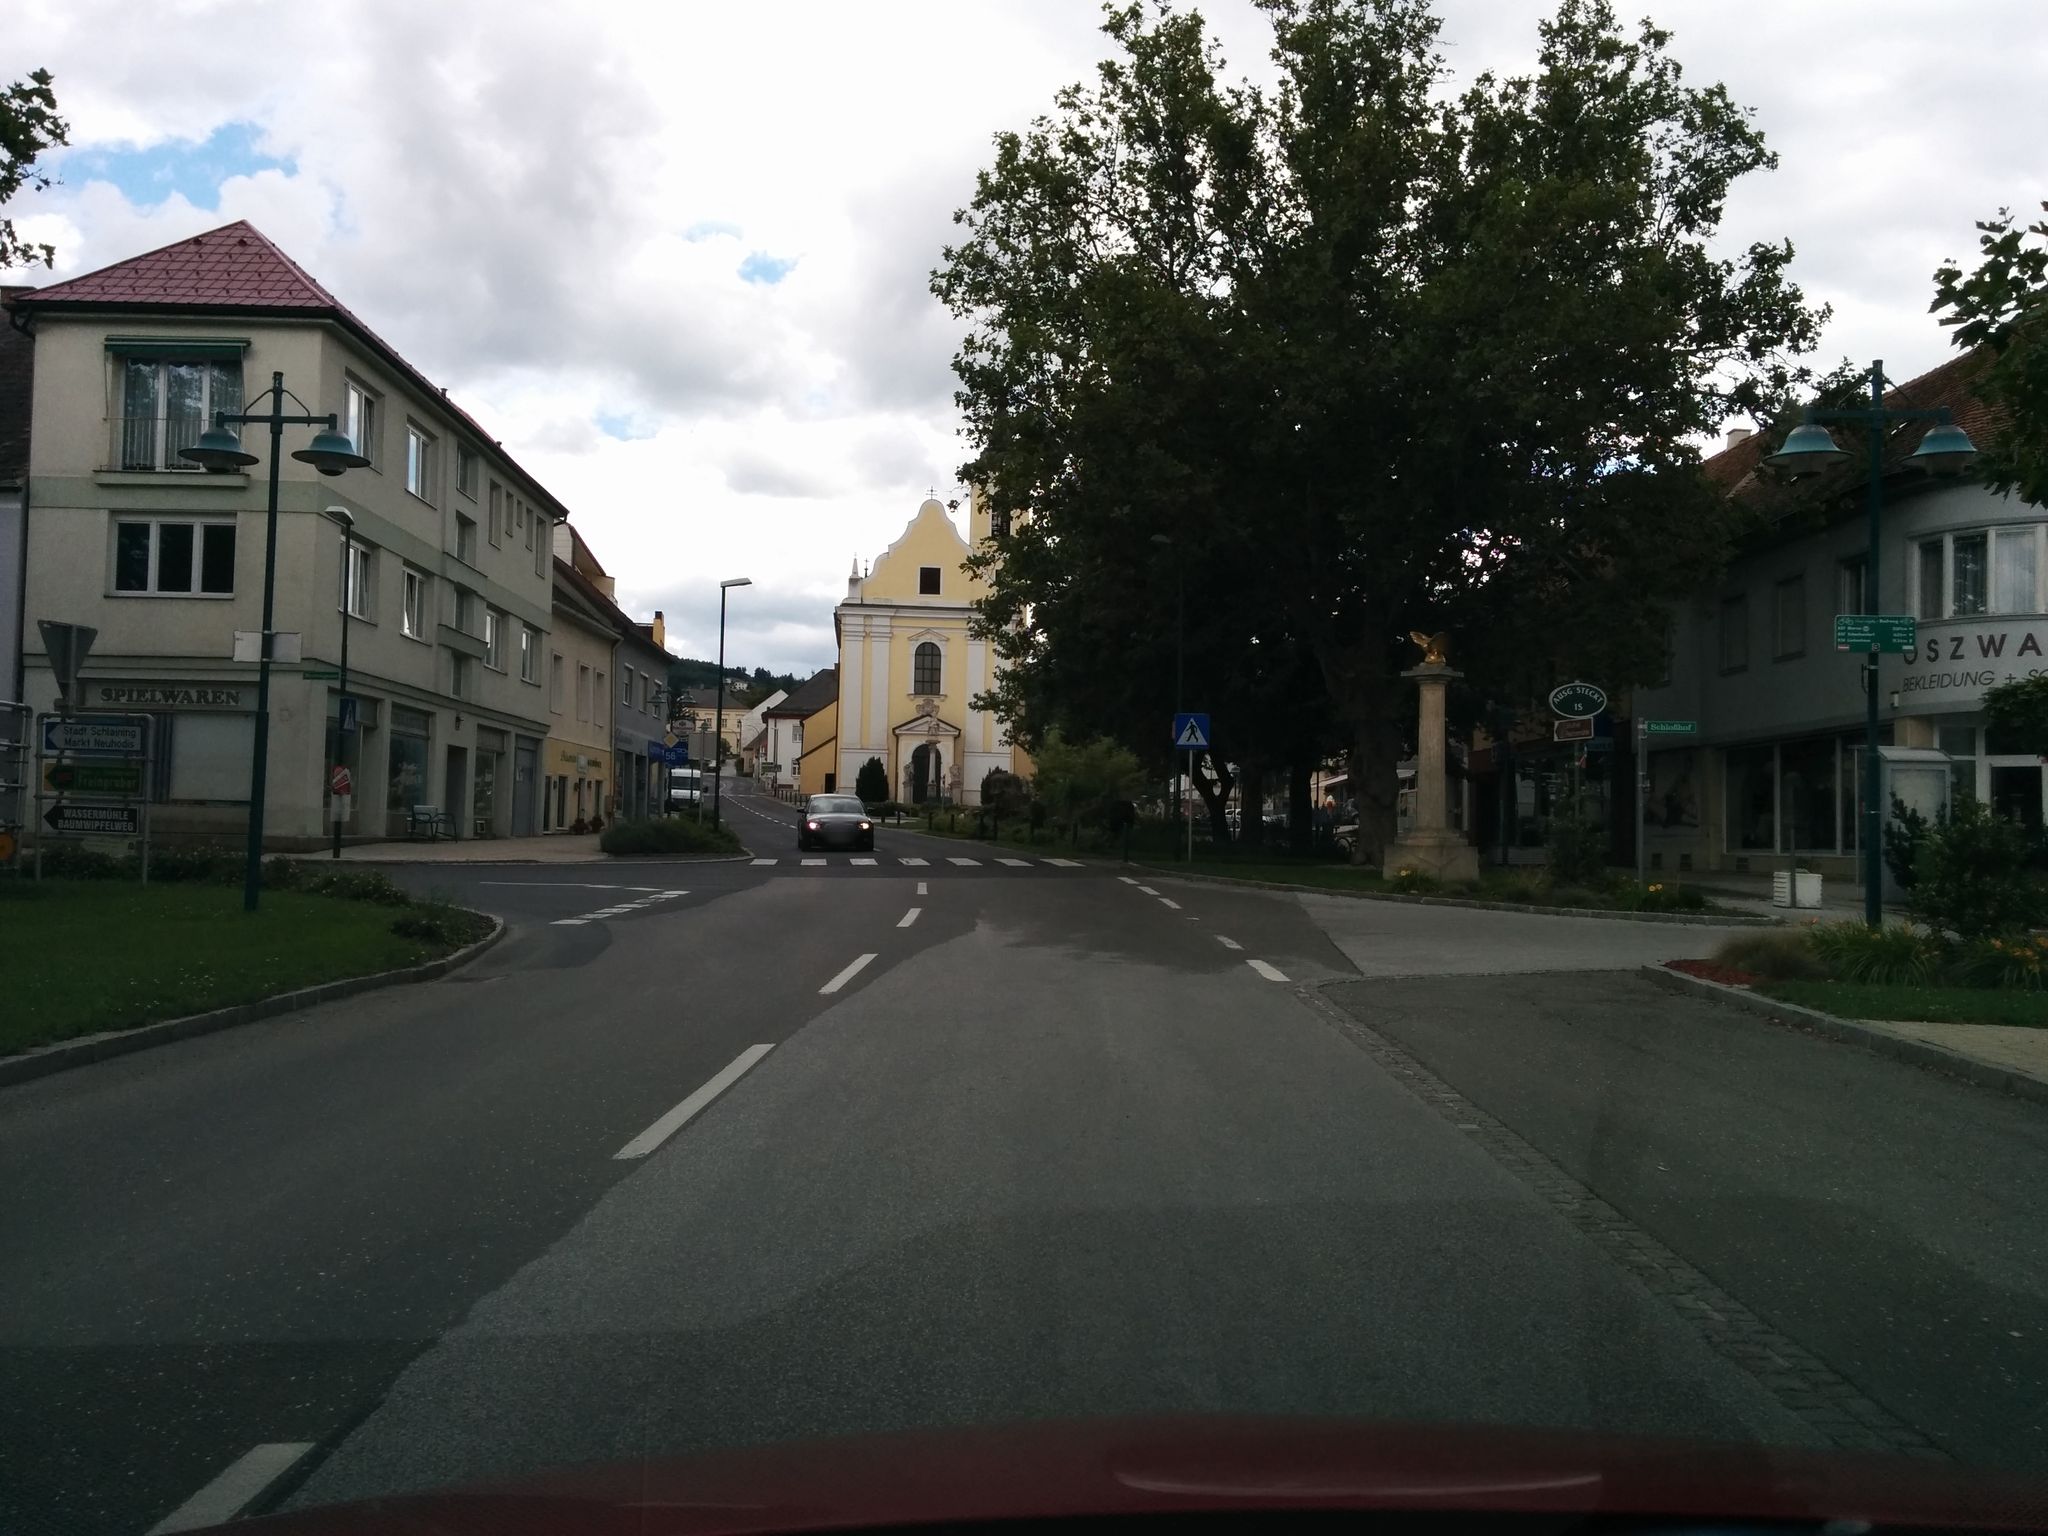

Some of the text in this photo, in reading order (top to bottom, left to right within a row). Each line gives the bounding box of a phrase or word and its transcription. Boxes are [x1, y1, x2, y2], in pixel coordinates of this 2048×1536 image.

[1903, 670, 1995, 692] BEKLEIDUNG
[101, 687, 241, 705] SPIELWAREN
[1574, 702, 1584, 711] IS
[64, 726, 136, 739] Stadt Schlaining
[64, 737, 90, 747] Markt
[63, 808, 129, 821] WASSERMÜHLE
